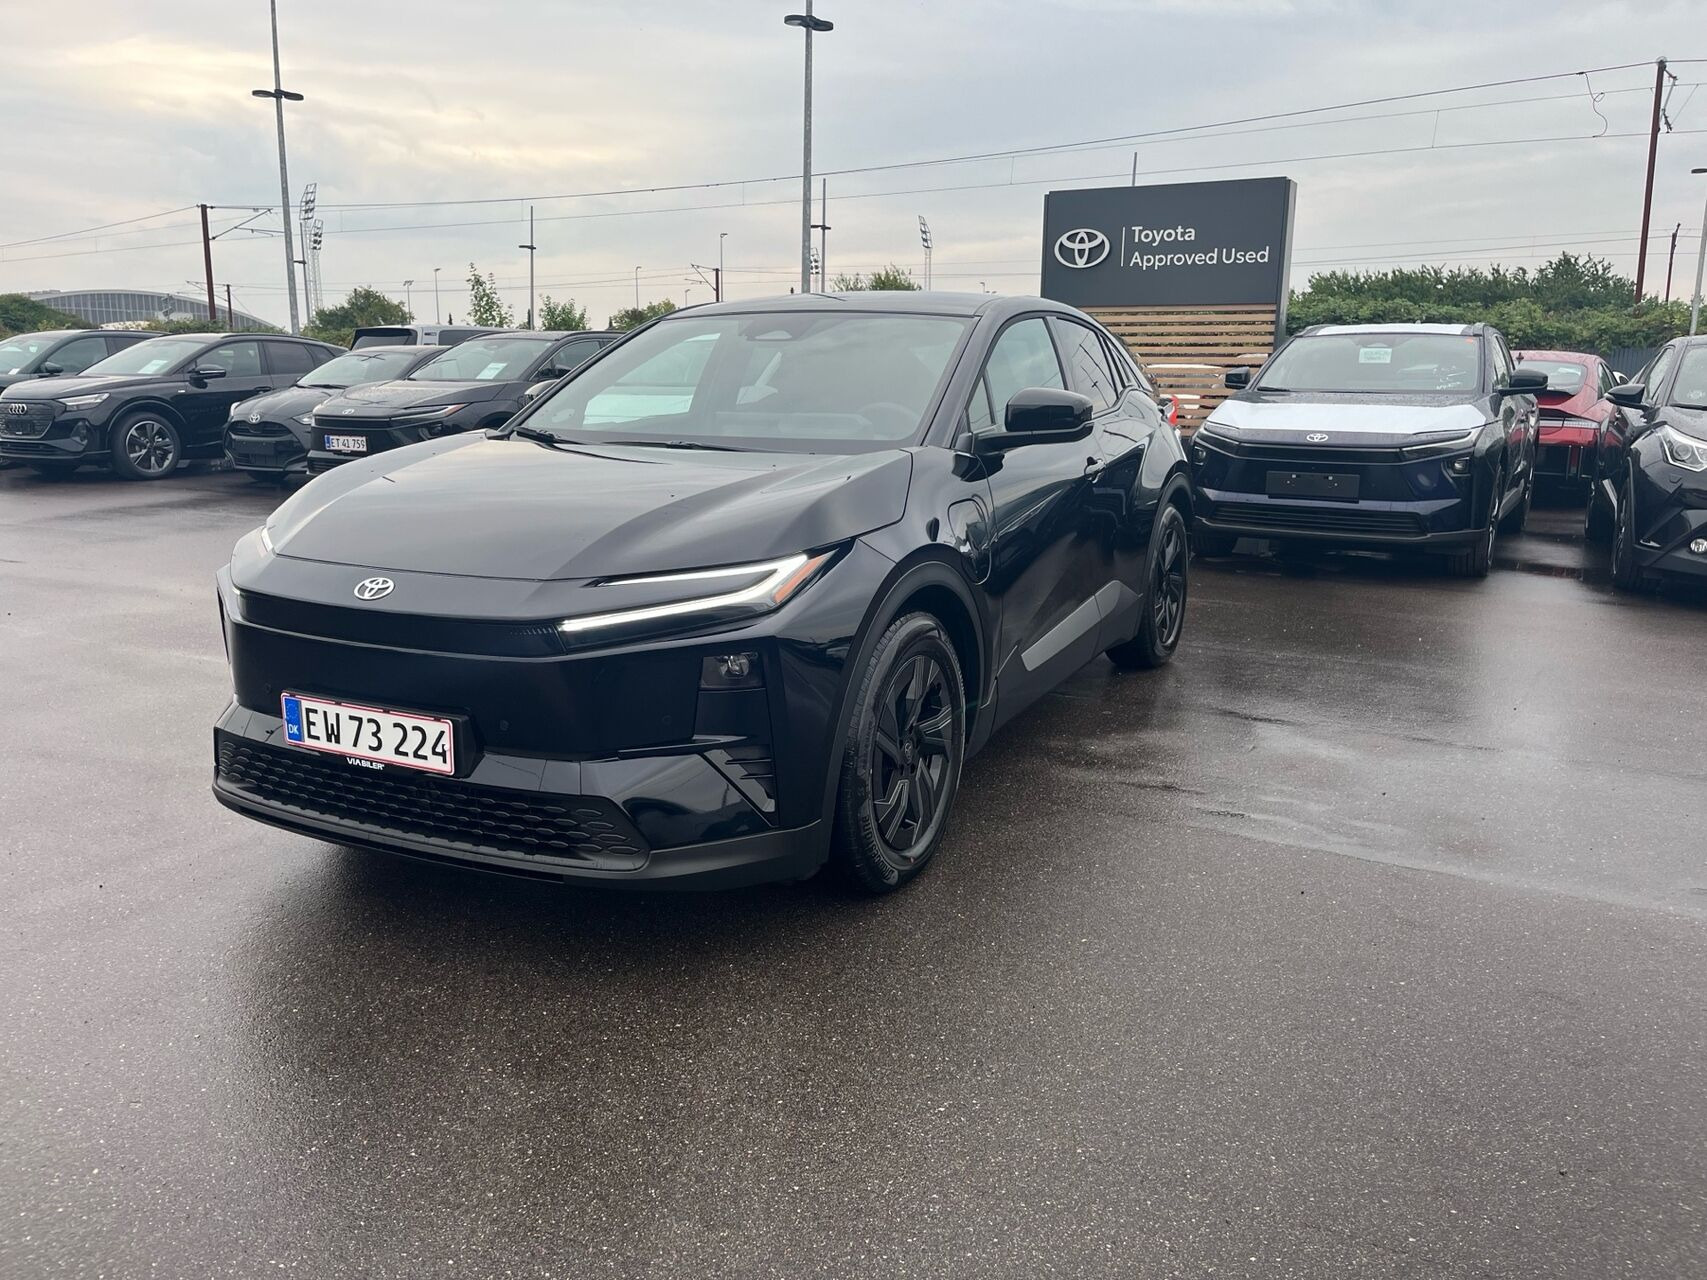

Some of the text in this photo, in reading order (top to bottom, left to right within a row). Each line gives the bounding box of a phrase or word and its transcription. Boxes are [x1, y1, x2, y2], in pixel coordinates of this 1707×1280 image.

[1131, 225, 1196, 247] Toyota
[1129, 246, 1270, 270] Approved Used
[331, 438, 340, 448] ET
[342, 438, 351, 448] 41
[288, 723, 299, 735] DK
[305, 707, 448, 765] EW 73 224
